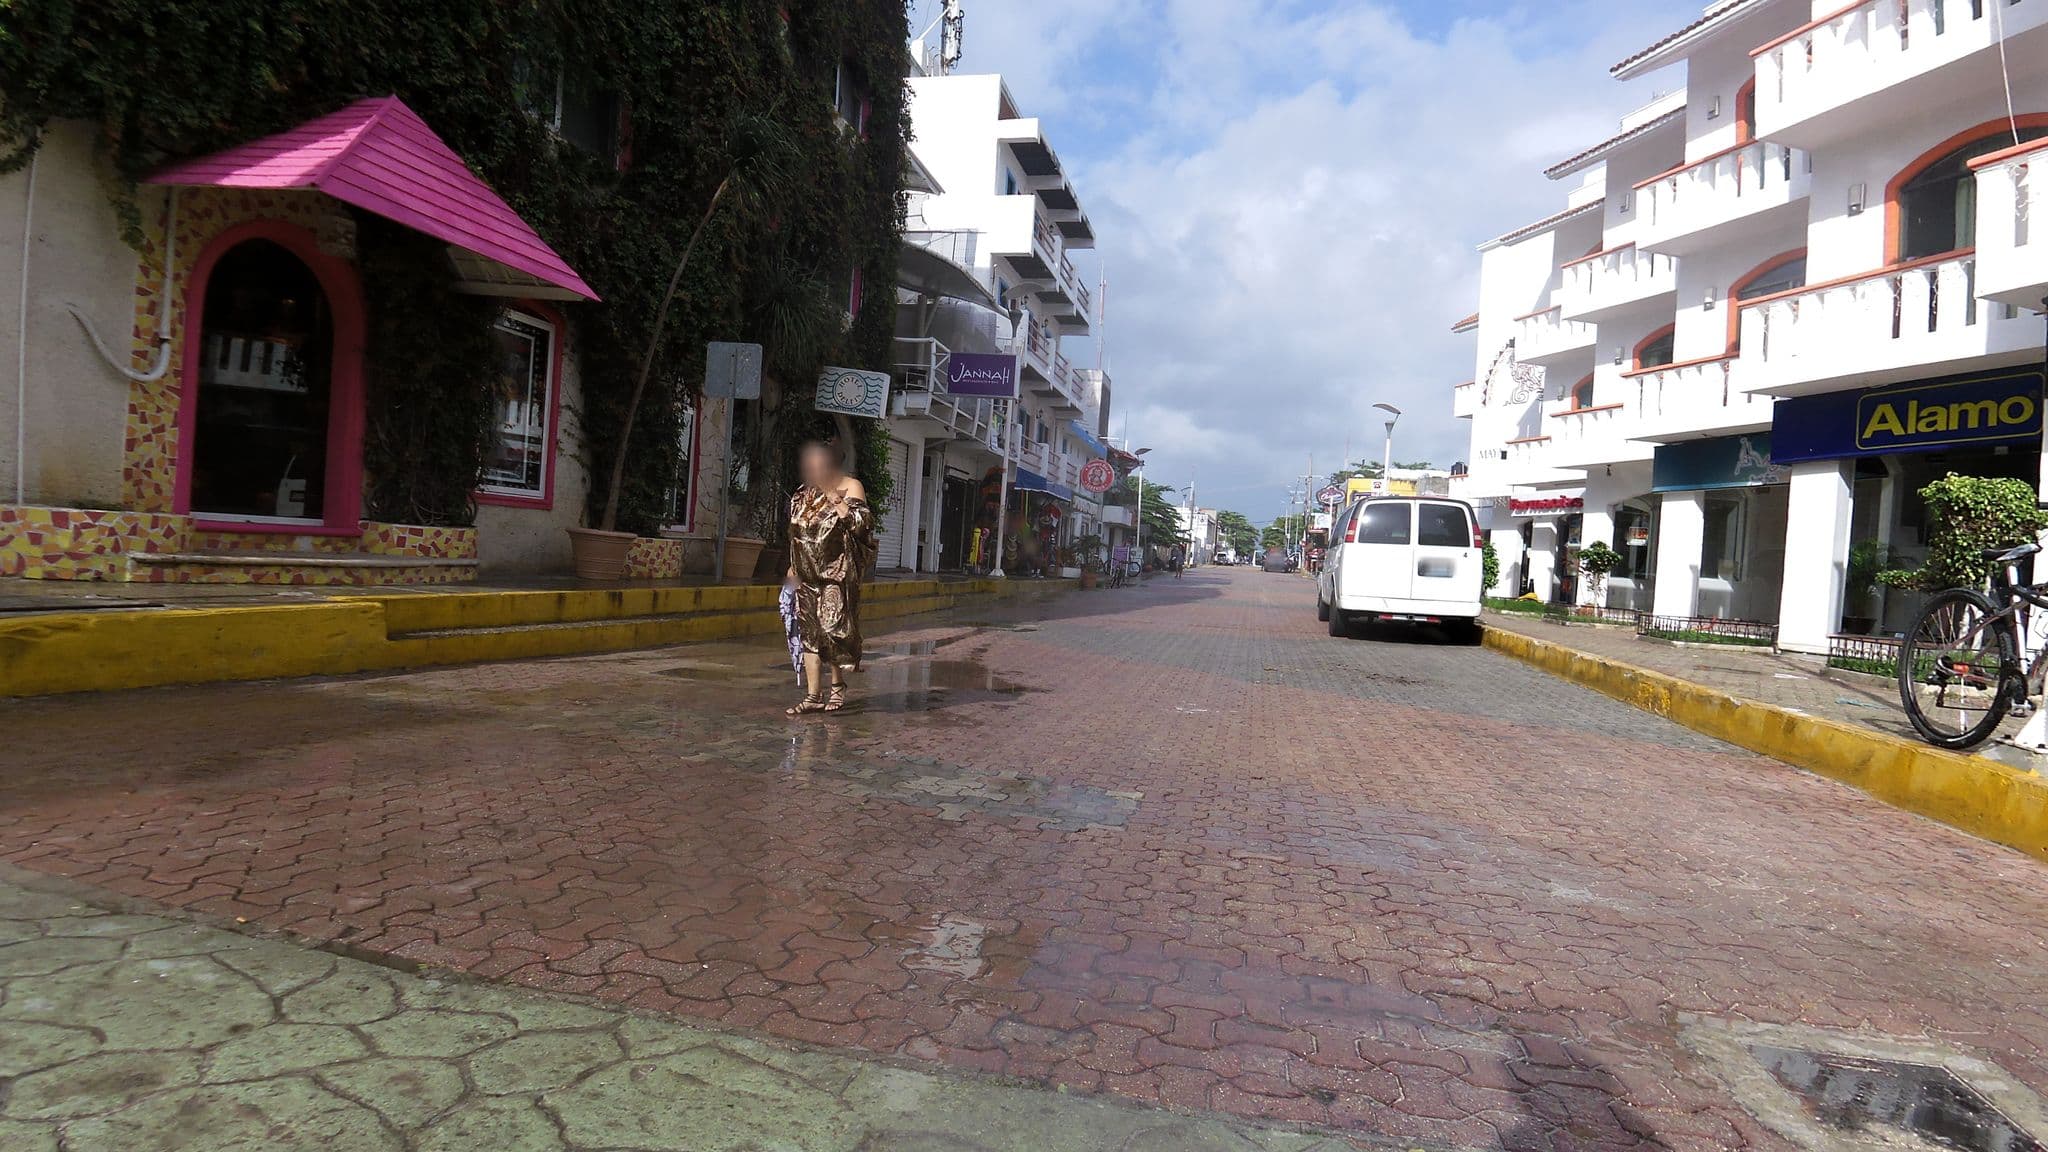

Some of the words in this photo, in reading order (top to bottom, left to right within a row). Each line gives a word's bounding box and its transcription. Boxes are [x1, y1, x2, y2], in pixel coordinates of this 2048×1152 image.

[839, 376, 863, 389] HOTEL
[950, 362, 1010, 385] JANNAH
[1861, 395, 2035, 440] Alamo
